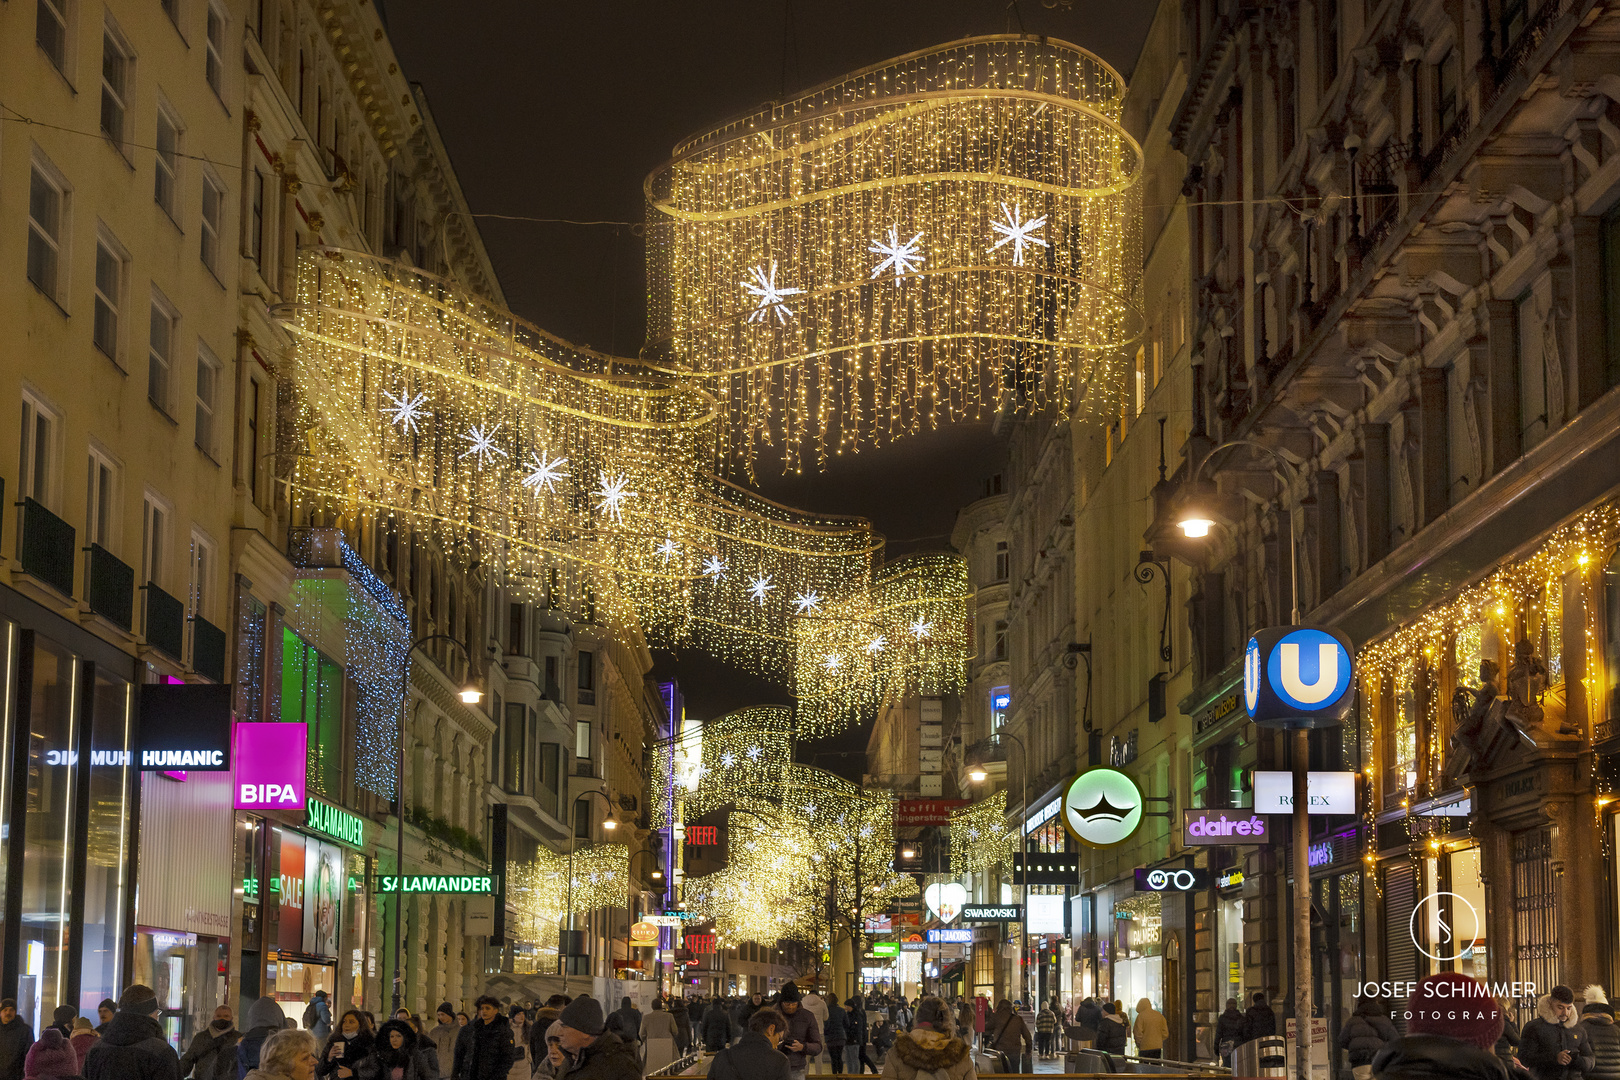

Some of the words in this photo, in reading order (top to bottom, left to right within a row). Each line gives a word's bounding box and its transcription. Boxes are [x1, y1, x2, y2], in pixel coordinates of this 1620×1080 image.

[1245, 647, 1258, 710] U
[1280, 643, 1338, 704] U
[142, 750, 223, 766] HUMANIC
[240, 784, 297, 803] BIPA
[1279, 795, 1330, 806] REX
[308, 797, 363, 847] SALAMANDER
[1189, 816, 1265, 836] claire's
[686, 826, 718, 845] STEFFL
[280, 874, 302, 909] SALE
[383, 877, 491, 891] SALAMANDER
[665, 911, 697, 919] DOUGLA
[964, 908, 1016, 918] SWAROVSKI
[685, 935, 717, 953] STEFFL
[944, 931, 972, 941] JACOBS
[1134, 926, 1158, 945] PALMERS
